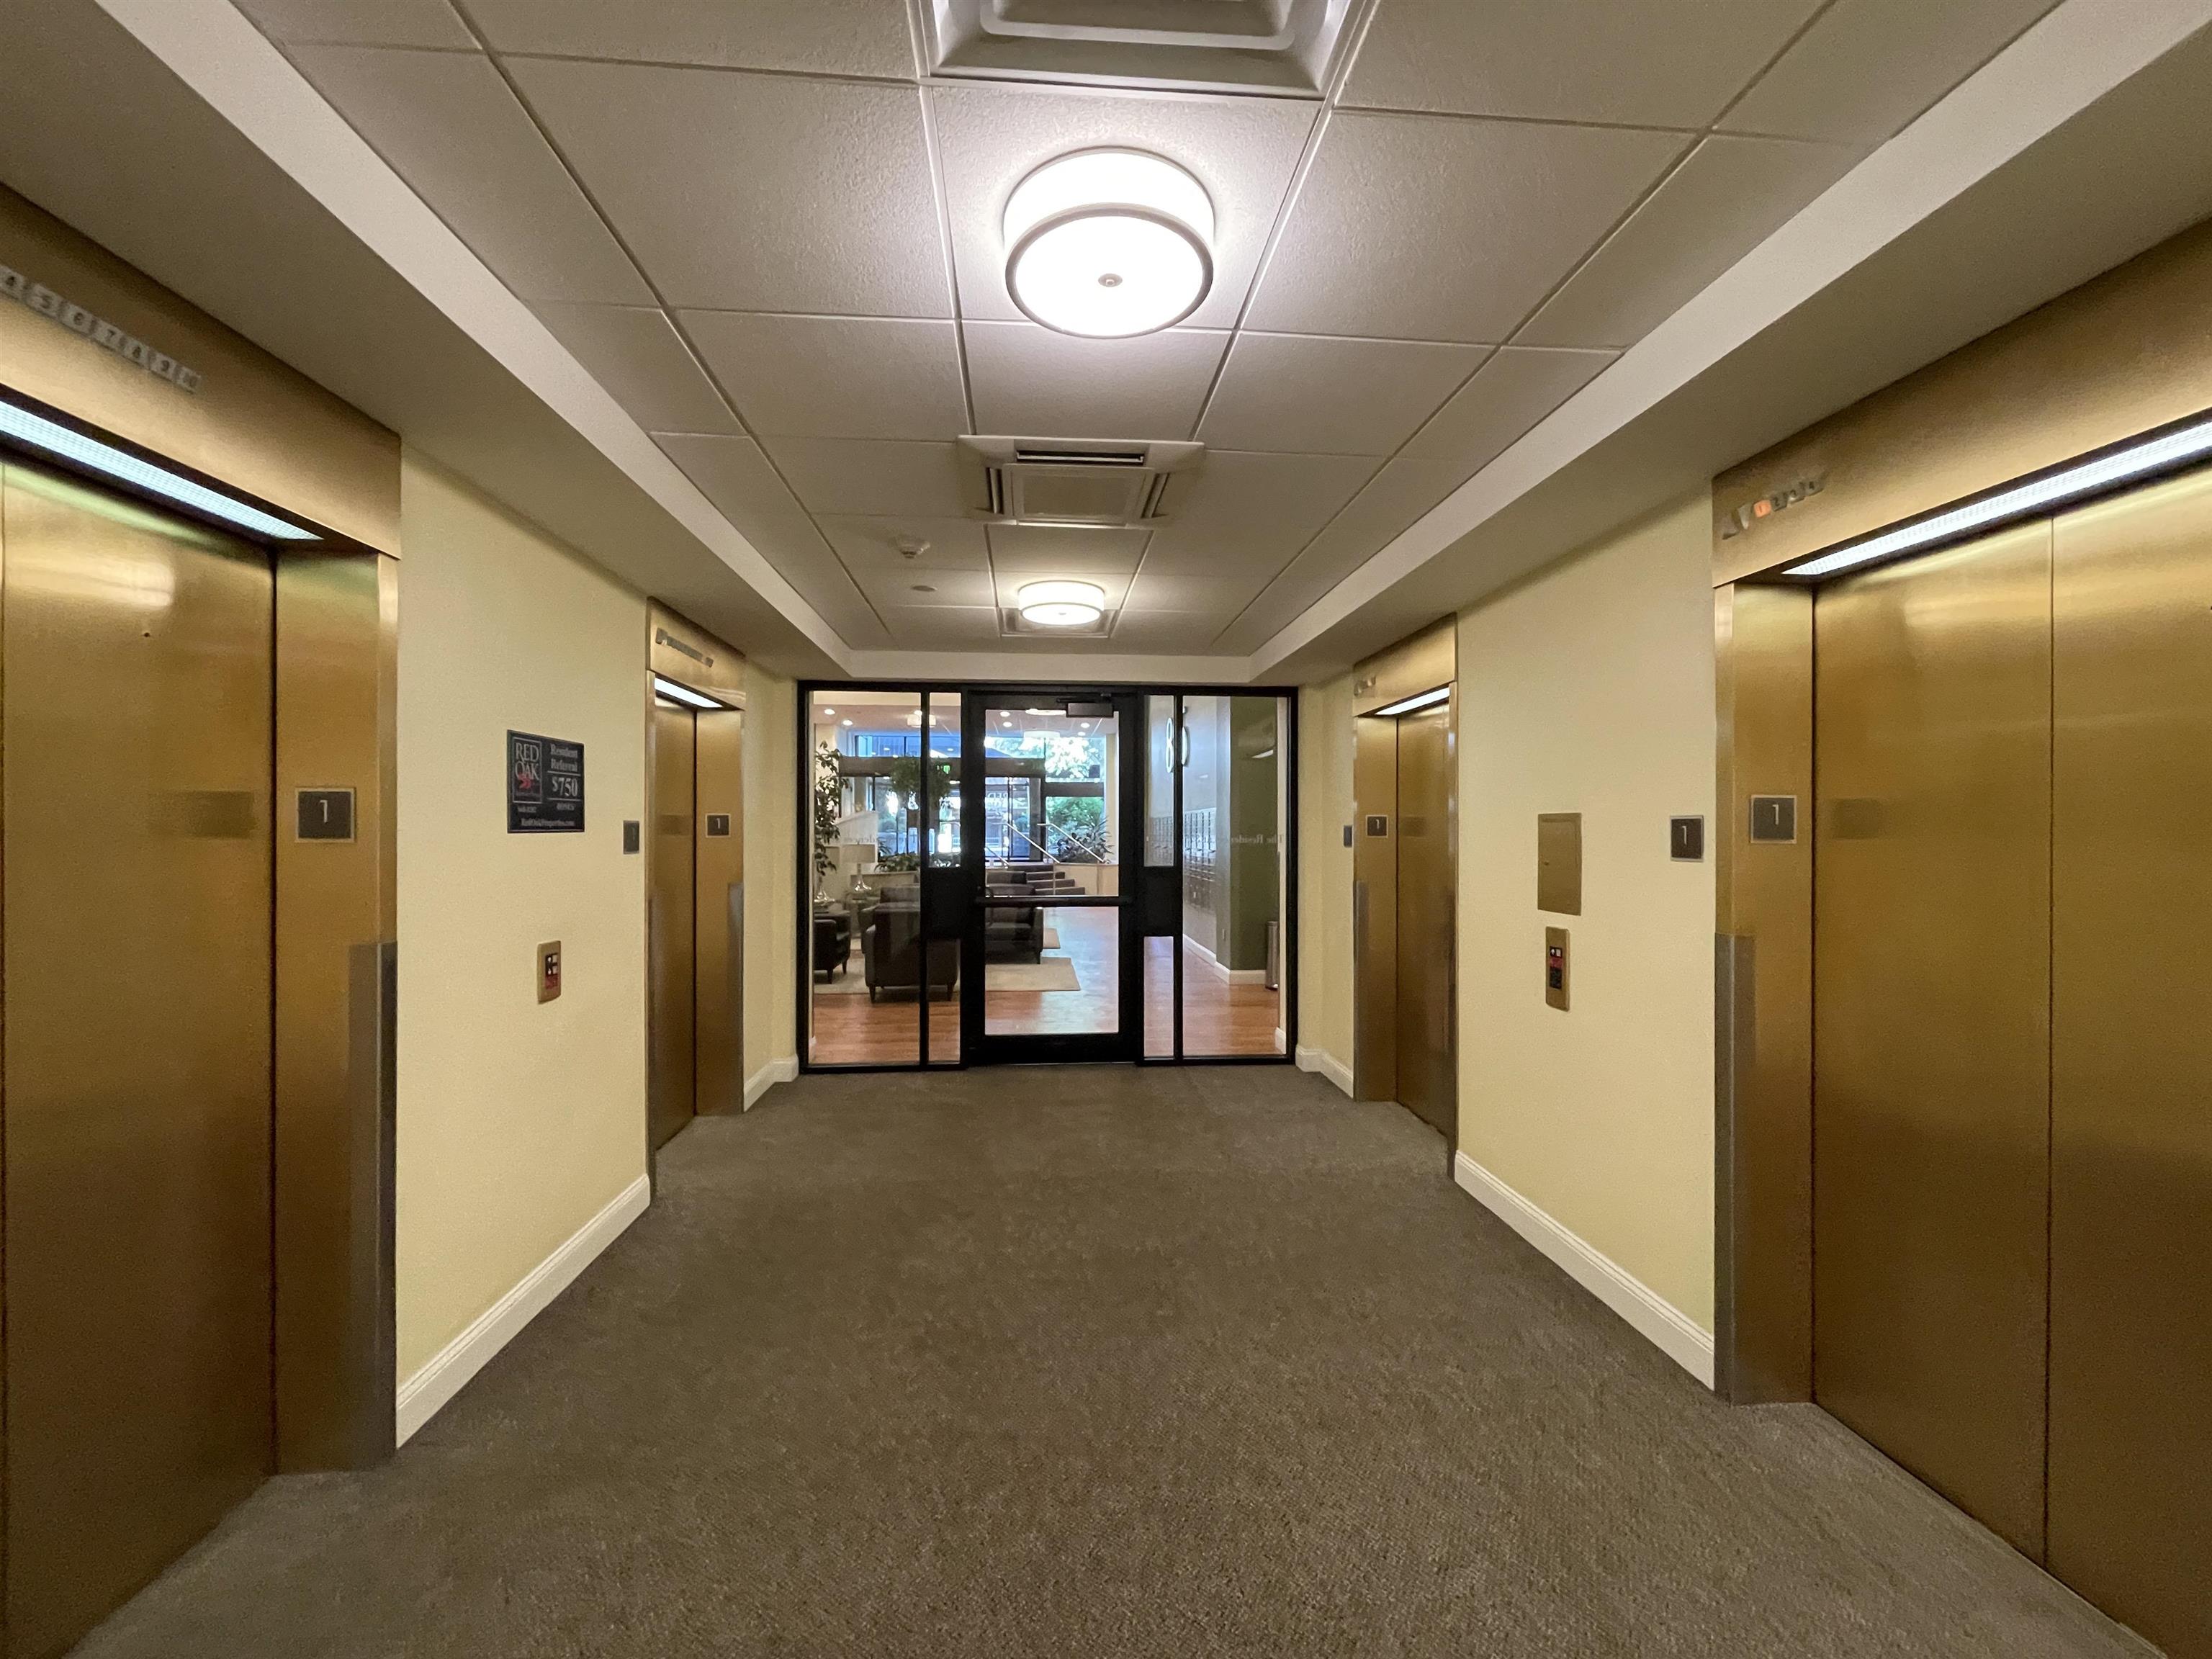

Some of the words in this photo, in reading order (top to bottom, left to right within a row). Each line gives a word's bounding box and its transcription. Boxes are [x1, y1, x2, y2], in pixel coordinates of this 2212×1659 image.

[516, 742, 539, 763] RED
[515, 761, 539, 781] OAK
[552, 776, 578, 797] $750
[319, 799, 328, 823] 1
[1772, 804, 1779, 825] 1
[716, 818, 721, 830] 1
[1375, 819, 1380, 830] 1
[1681, 825, 1687, 845] 1
